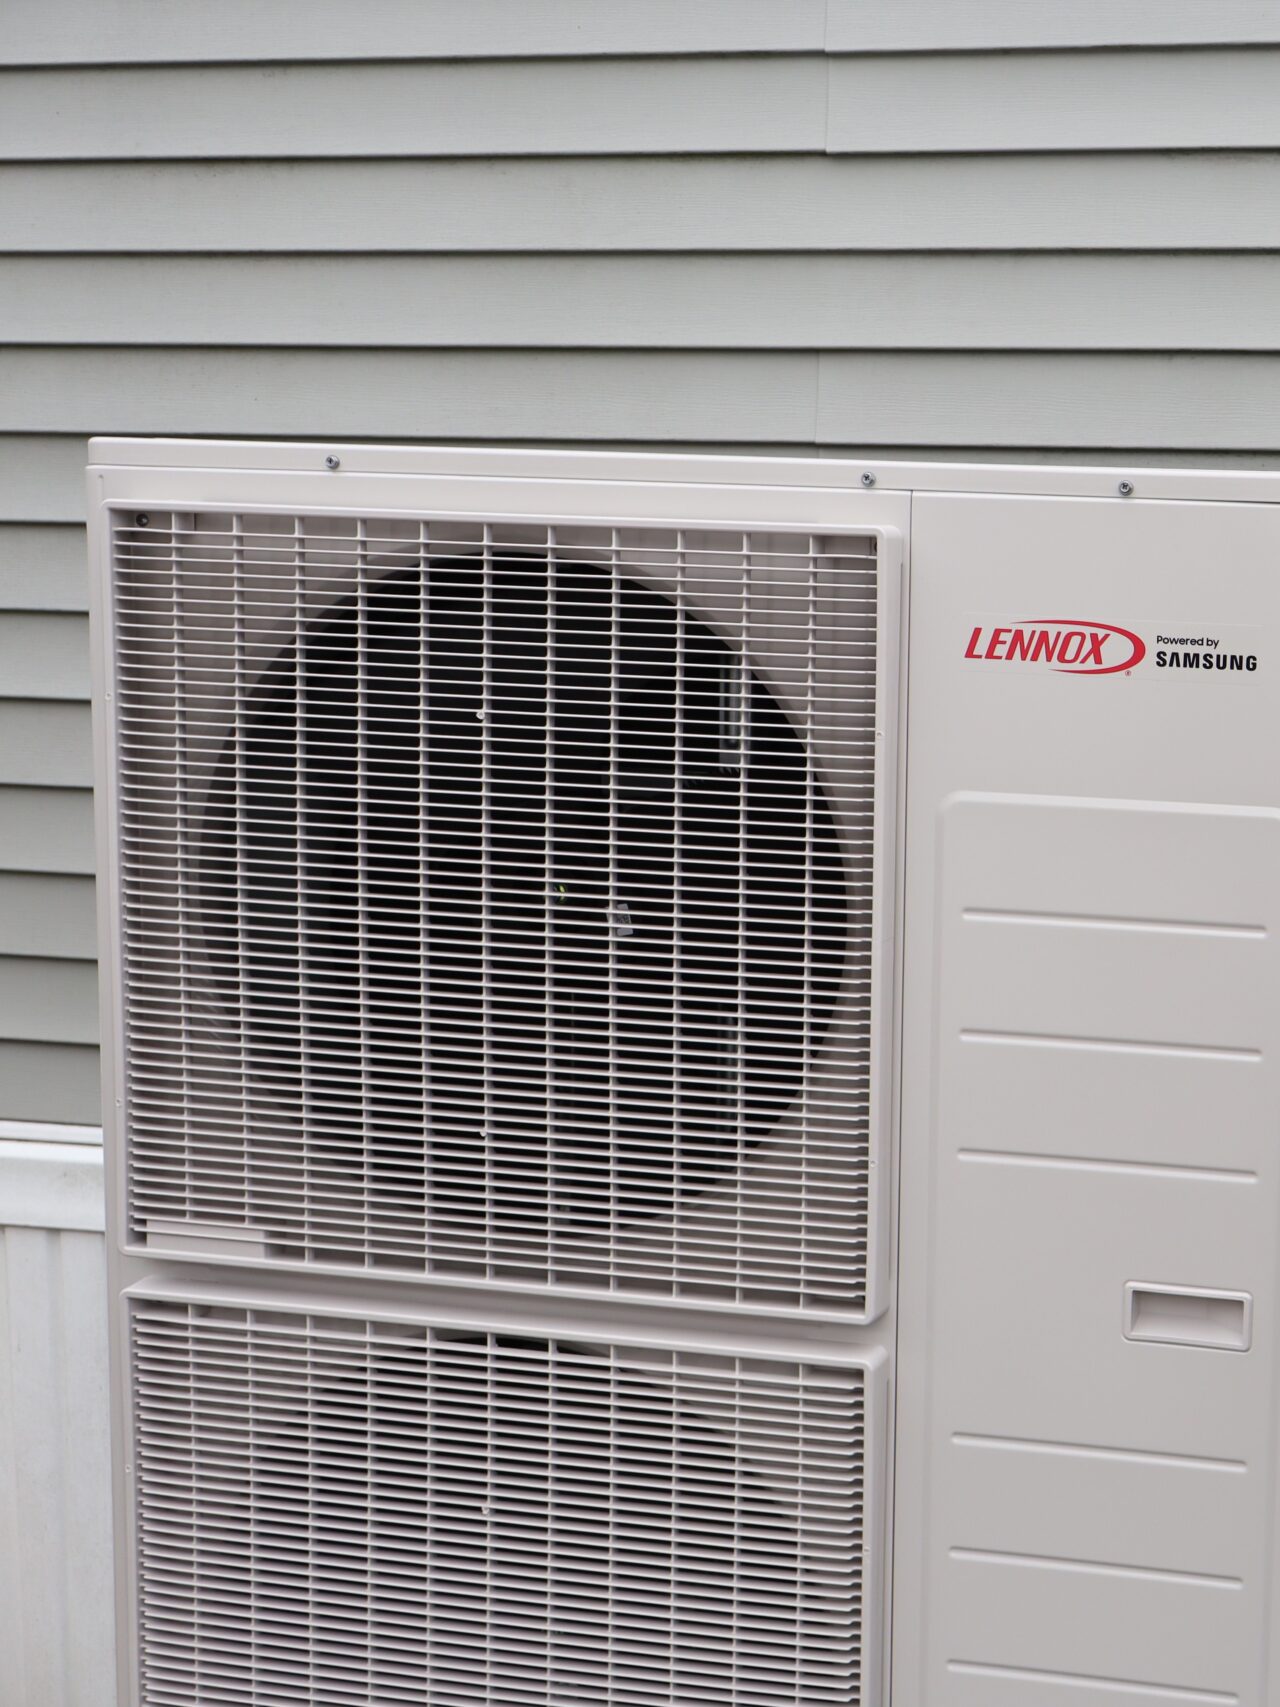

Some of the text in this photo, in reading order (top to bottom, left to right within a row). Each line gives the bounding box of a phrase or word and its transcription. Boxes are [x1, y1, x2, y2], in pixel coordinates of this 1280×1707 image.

[964, 627, 1110, 665] LENNOX
[1156, 635, 1219, 649] Powered by
[1155, 651, 1257, 671] SAMSUNG
